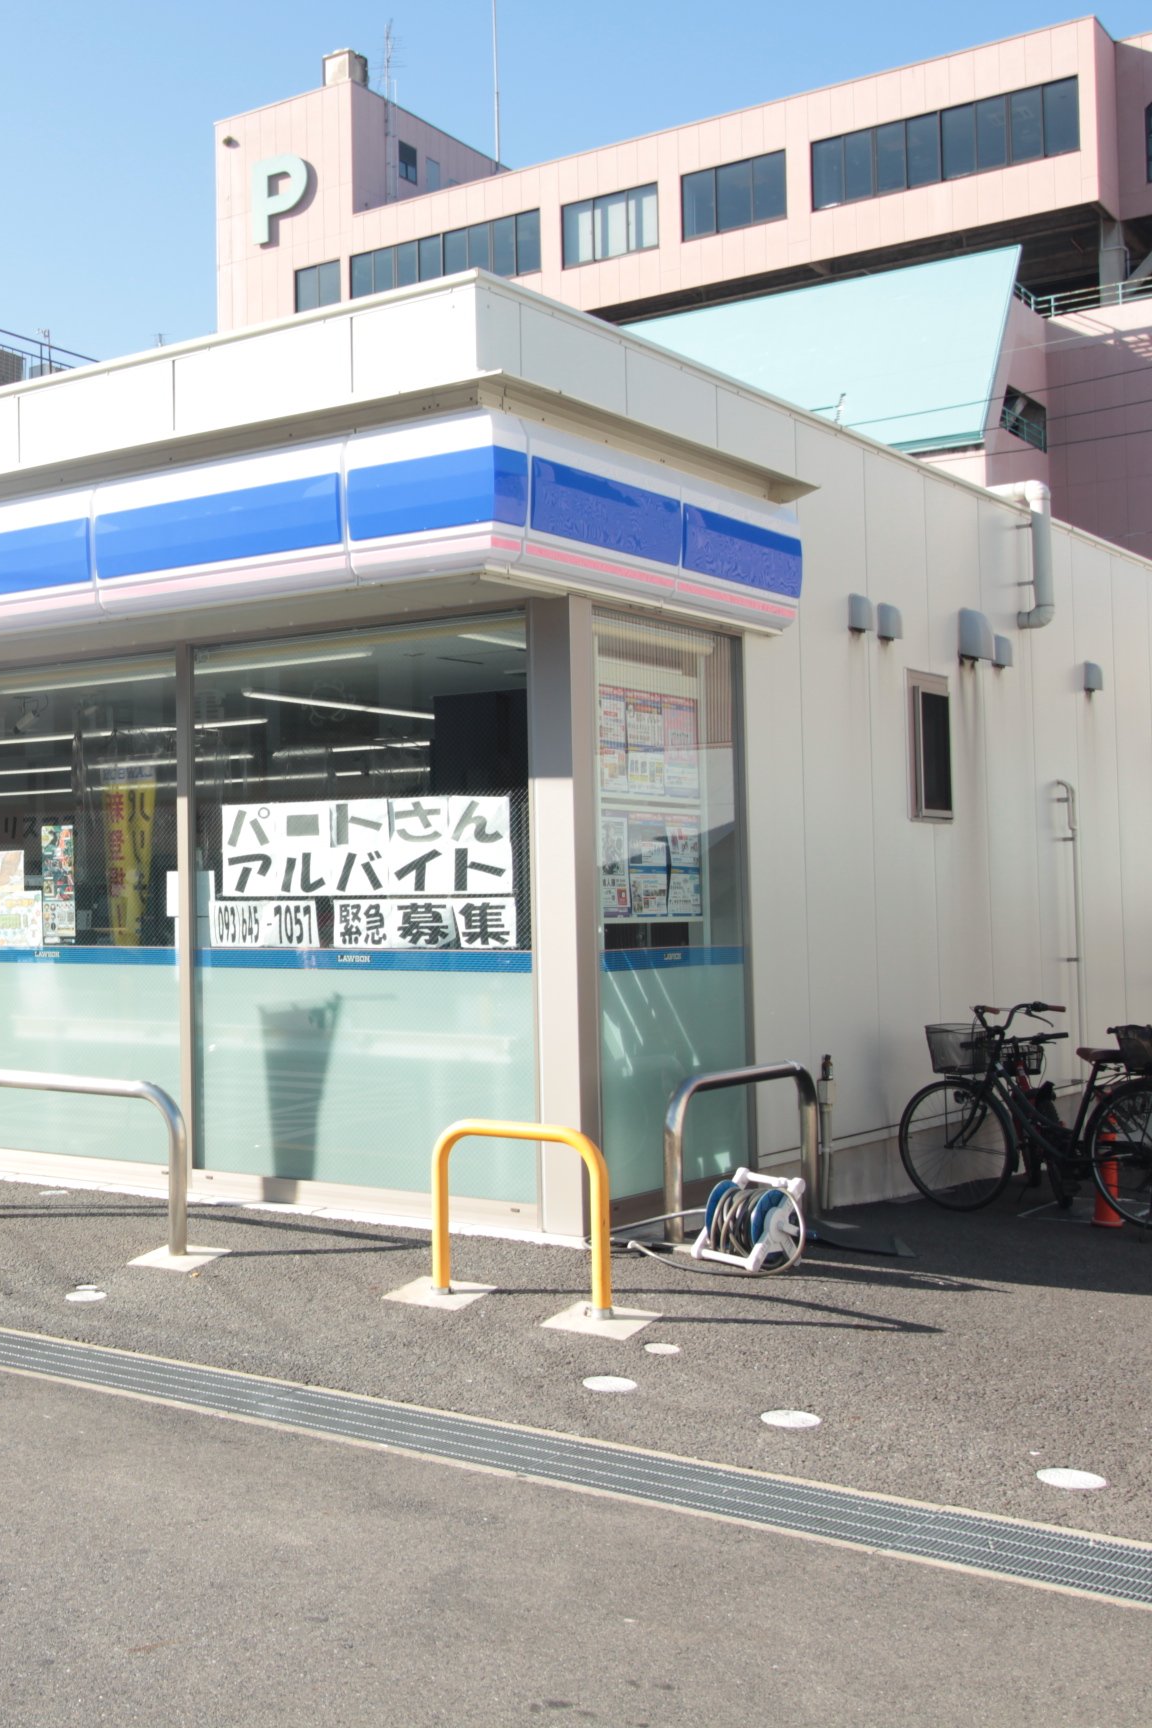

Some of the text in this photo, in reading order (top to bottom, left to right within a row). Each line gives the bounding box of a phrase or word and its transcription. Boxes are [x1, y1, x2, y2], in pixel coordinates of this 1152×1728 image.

[251, 153, 309, 245] P
[228, 799, 504, 848] パートさん
[228, 848, 506, 893] アルバイト
[339, 901, 512, 945] 緊急募集
[337, 954, 371, 963] LAWSON
